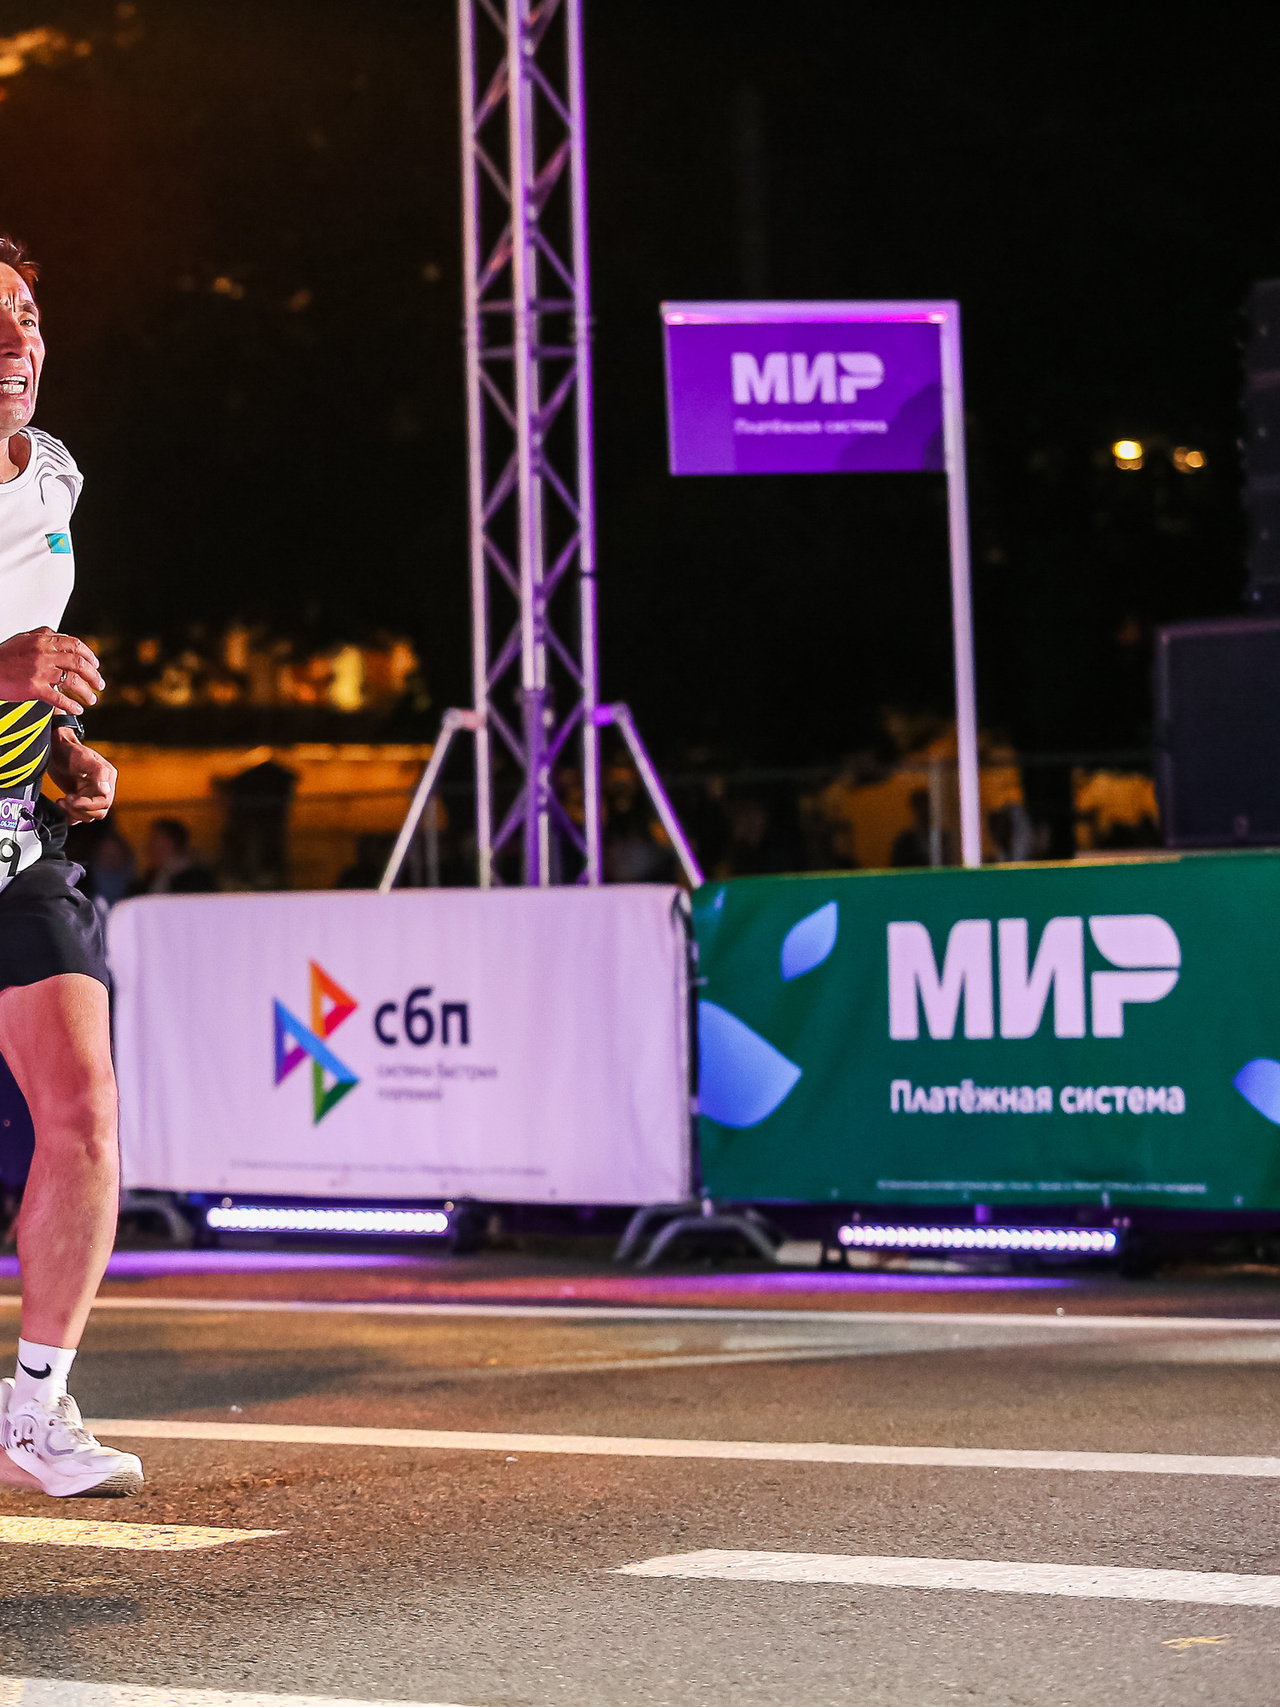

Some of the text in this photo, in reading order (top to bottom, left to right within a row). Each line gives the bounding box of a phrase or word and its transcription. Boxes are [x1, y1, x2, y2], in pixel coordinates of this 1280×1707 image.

[731, 352, 884, 404] МИР
[887, 914, 1182, 1041] МИР
[374, 986, 470, 1047] сбп
[890, 1079, 1186, 1114] Платёжная система
